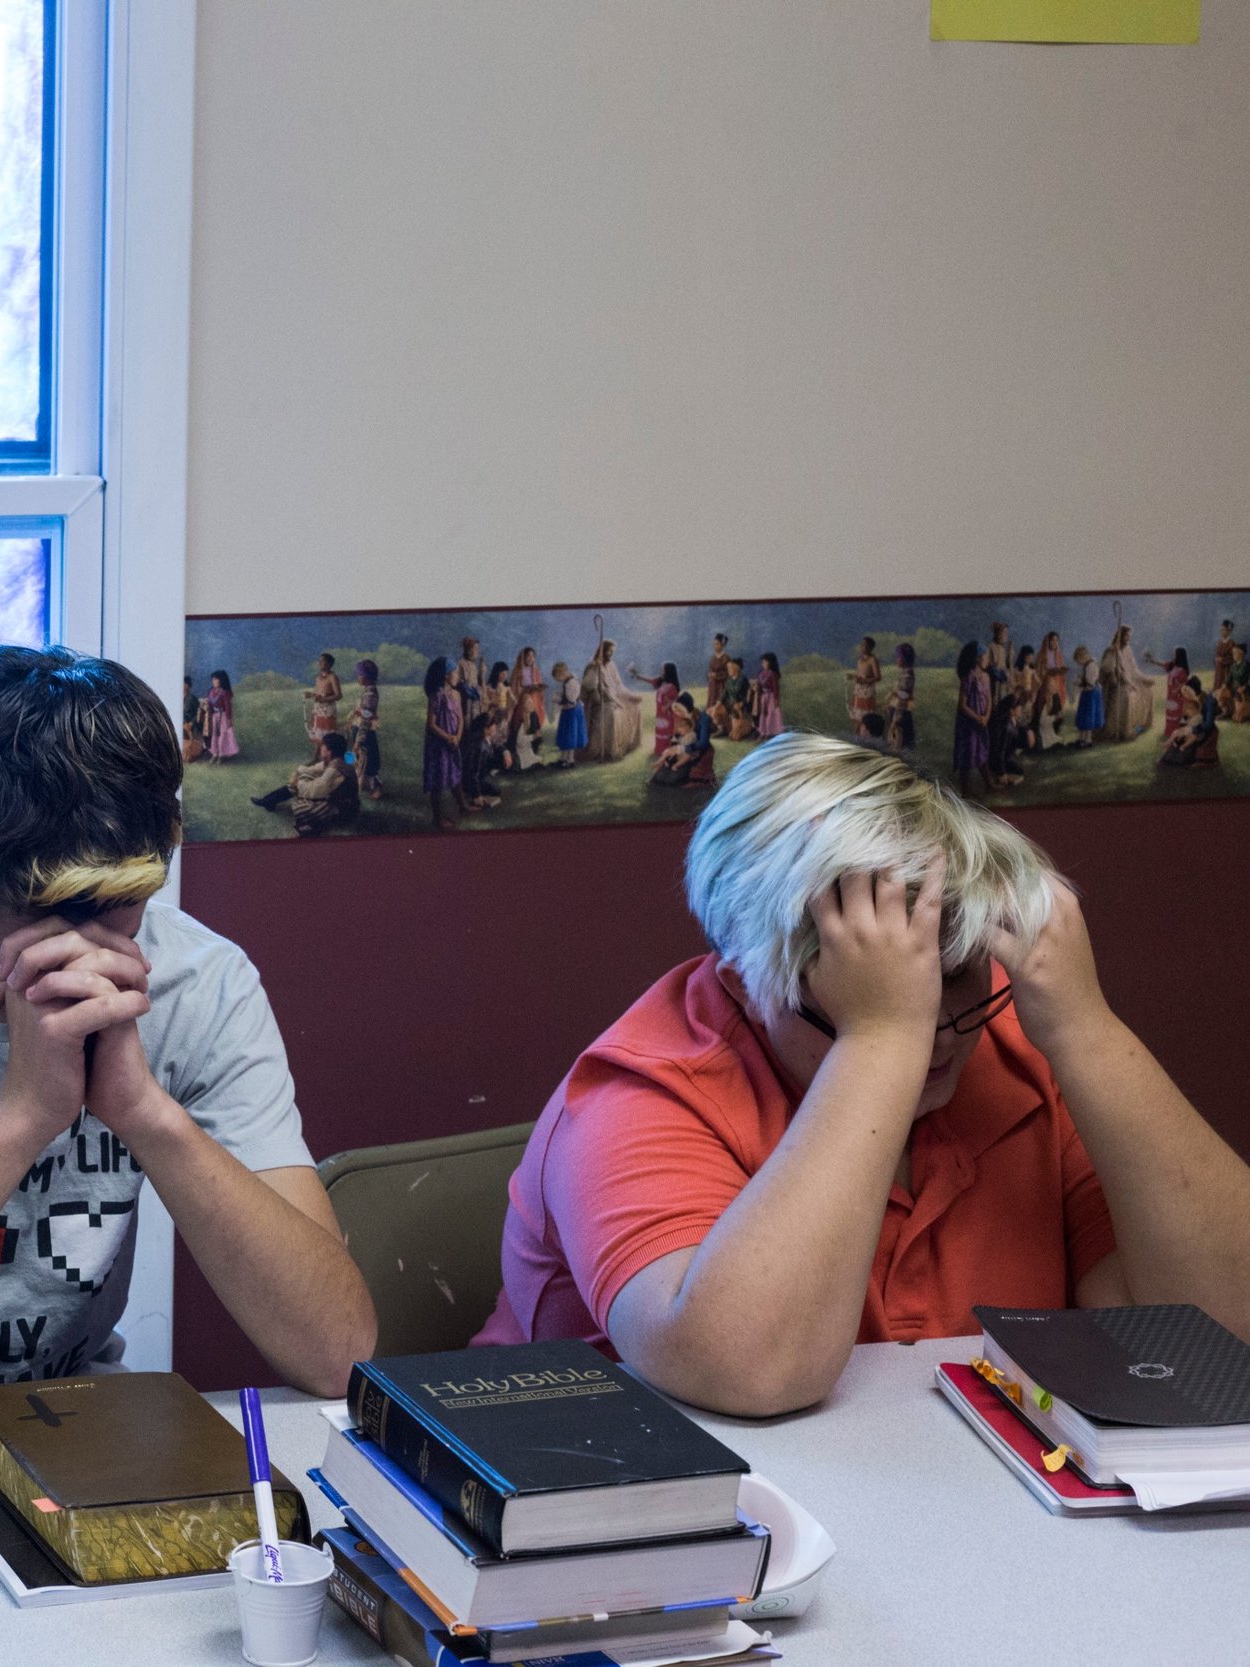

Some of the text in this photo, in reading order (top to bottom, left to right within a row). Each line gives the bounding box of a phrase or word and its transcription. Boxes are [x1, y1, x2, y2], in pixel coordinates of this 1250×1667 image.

[420, 1367, 608, 1398] Holy Bible
[442, 1382, 623, 1408] New International Version
[332, 1567, 376, 1611] STUDENT
